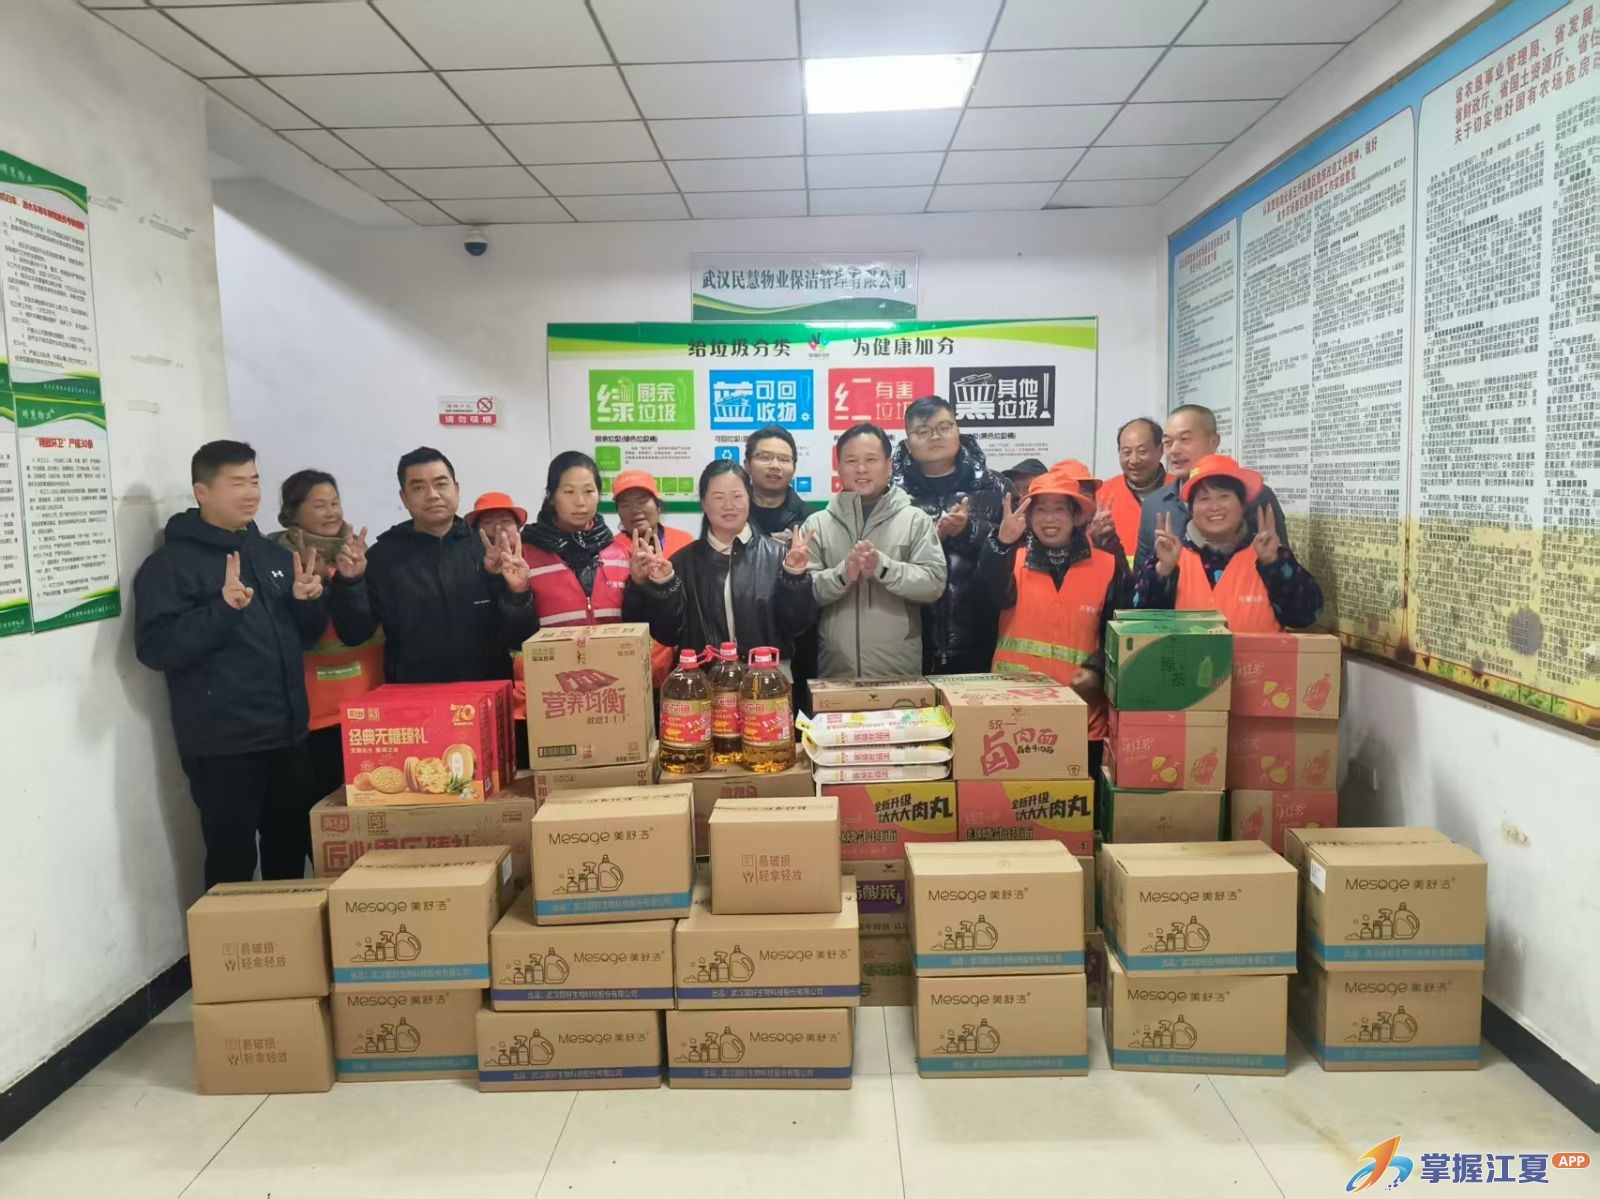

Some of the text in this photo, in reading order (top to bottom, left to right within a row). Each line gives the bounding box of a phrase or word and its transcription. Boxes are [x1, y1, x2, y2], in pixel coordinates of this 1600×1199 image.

[702, 269, 906, 290] 武汉民慧物业保洁管理有限公司
[688, 337, 955, 357] 给垃圾分类 为健康加分
[637, 383, 676, 402] 厨余
[755, 379, 797, 401] 可回
[875, 381, 913, 399] 有害
[998, 378, 1038, 399] 其他
[638, 403, 676, 422] 垃圾
[757, 402, 797, 422] 收物
[998, 400, 1038, 420] 垃圾
[542, 687, 626, 720] 营养均衡
[988, 719, 1017, 730] 统一
[349, 727, 428, 746] 经典无糖臻礼
[874, 793, 912, 812] 全新升级
[1012, 792, 1049, 810] 全新升级
[549, 831, 650, 846] Mesoge 美舒洁
[758, 855, 792, 867] 易破损
[759, 869, 802, 882] 轻拿轻放
[1345, 878, 1451, 892] Mesoge 美舒洁
[928, 888, 1023, 903] Mesoge 美舒洁
[1139, 890, 1237, 904] Mesoge 美舒洁
[346, 901, 447, 914] Mesoge 美舒洁
[573, 951, 662, 964] Mesoge 美舒洁
[759, 949, 848, 962] Mesoge 美舒洁
[1128, 988, 1225, 1003] Mesoge 美舒洁
[1345, 981, 1448, 995] Mesoge 美舒洁
[347, 994, 407, 1008] Mesoge
[931, 993, 1026, 1007] Mesoge 美舒洁
[558, 1032, 646, 1045] Mesoge 美舒洁
[750, 1031, 838, 1045] Mesoge 美舒洁
